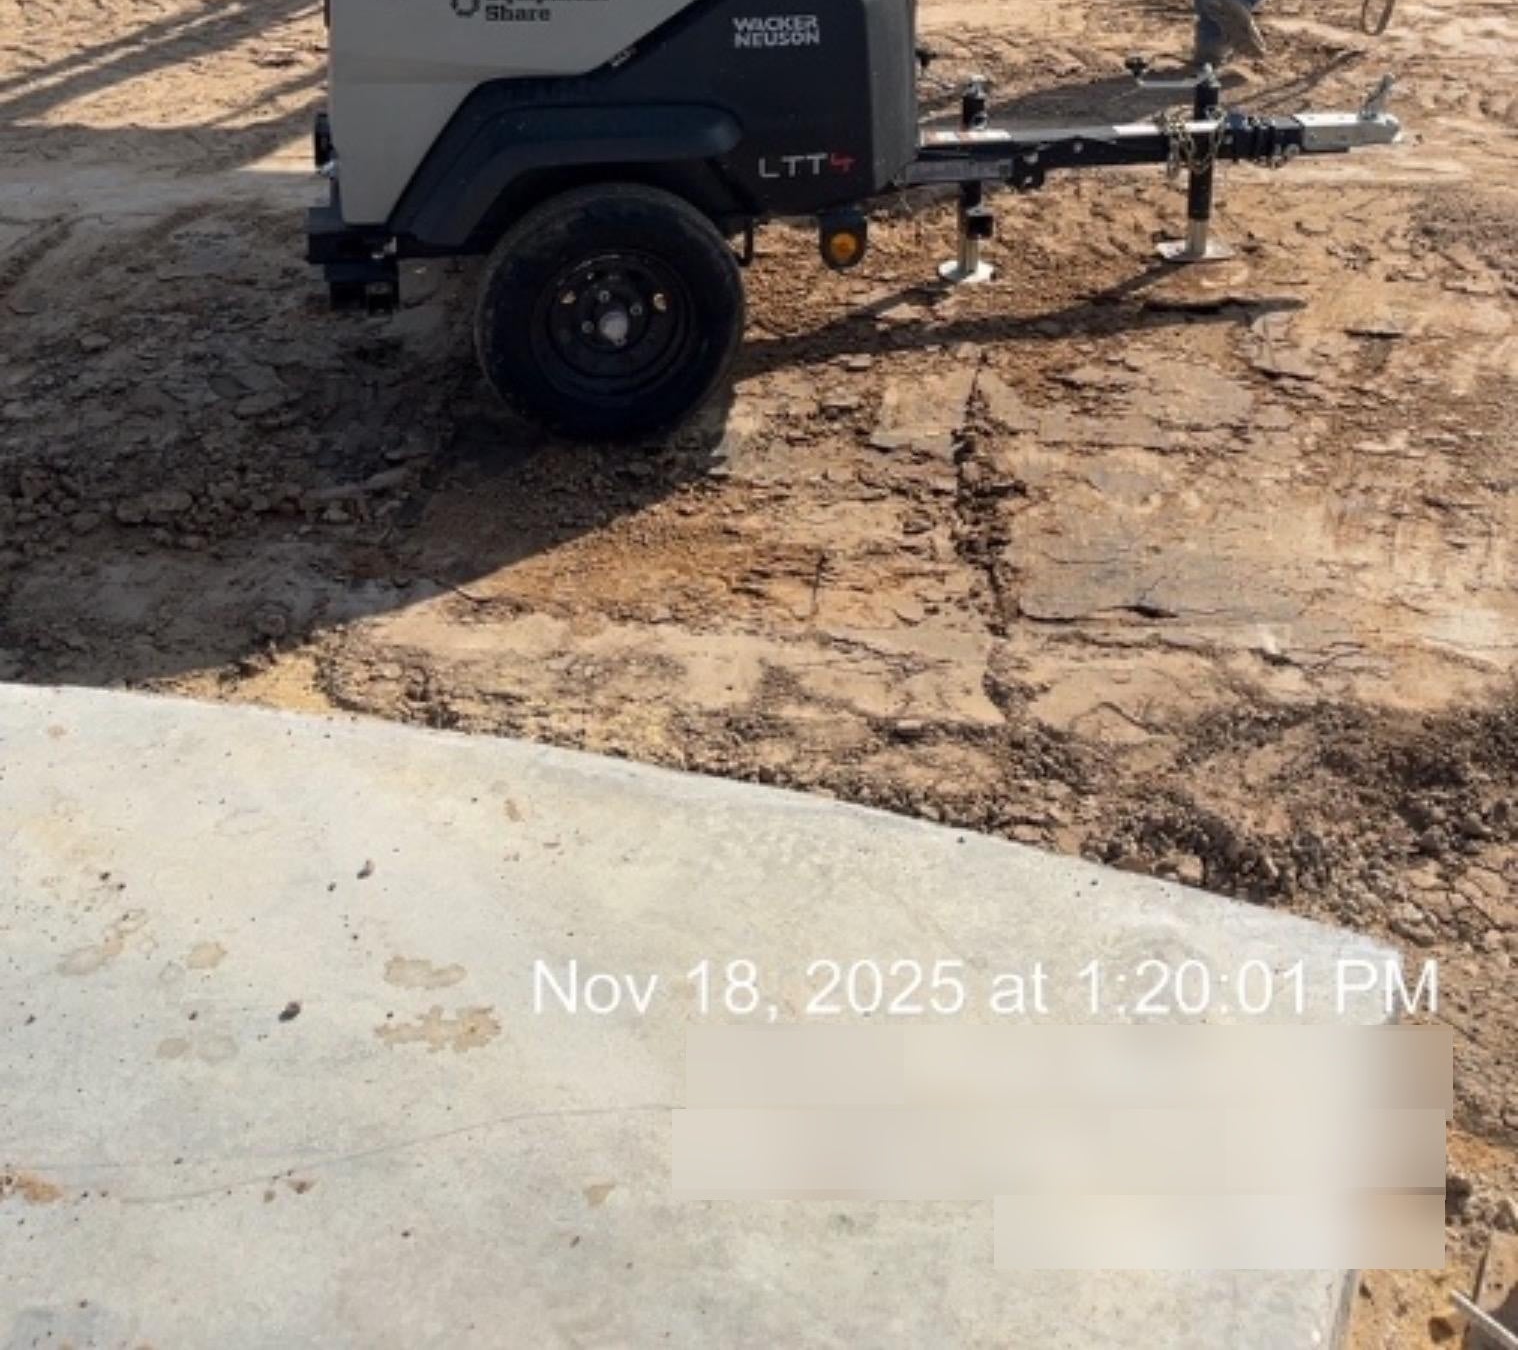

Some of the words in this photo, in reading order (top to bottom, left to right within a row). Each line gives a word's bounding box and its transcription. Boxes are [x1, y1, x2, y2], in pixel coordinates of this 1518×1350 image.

[485, 5, 551, 22] Share
[733, 14, 819, 32] WACKER
[734, 27, 821, 49] NEUSON
